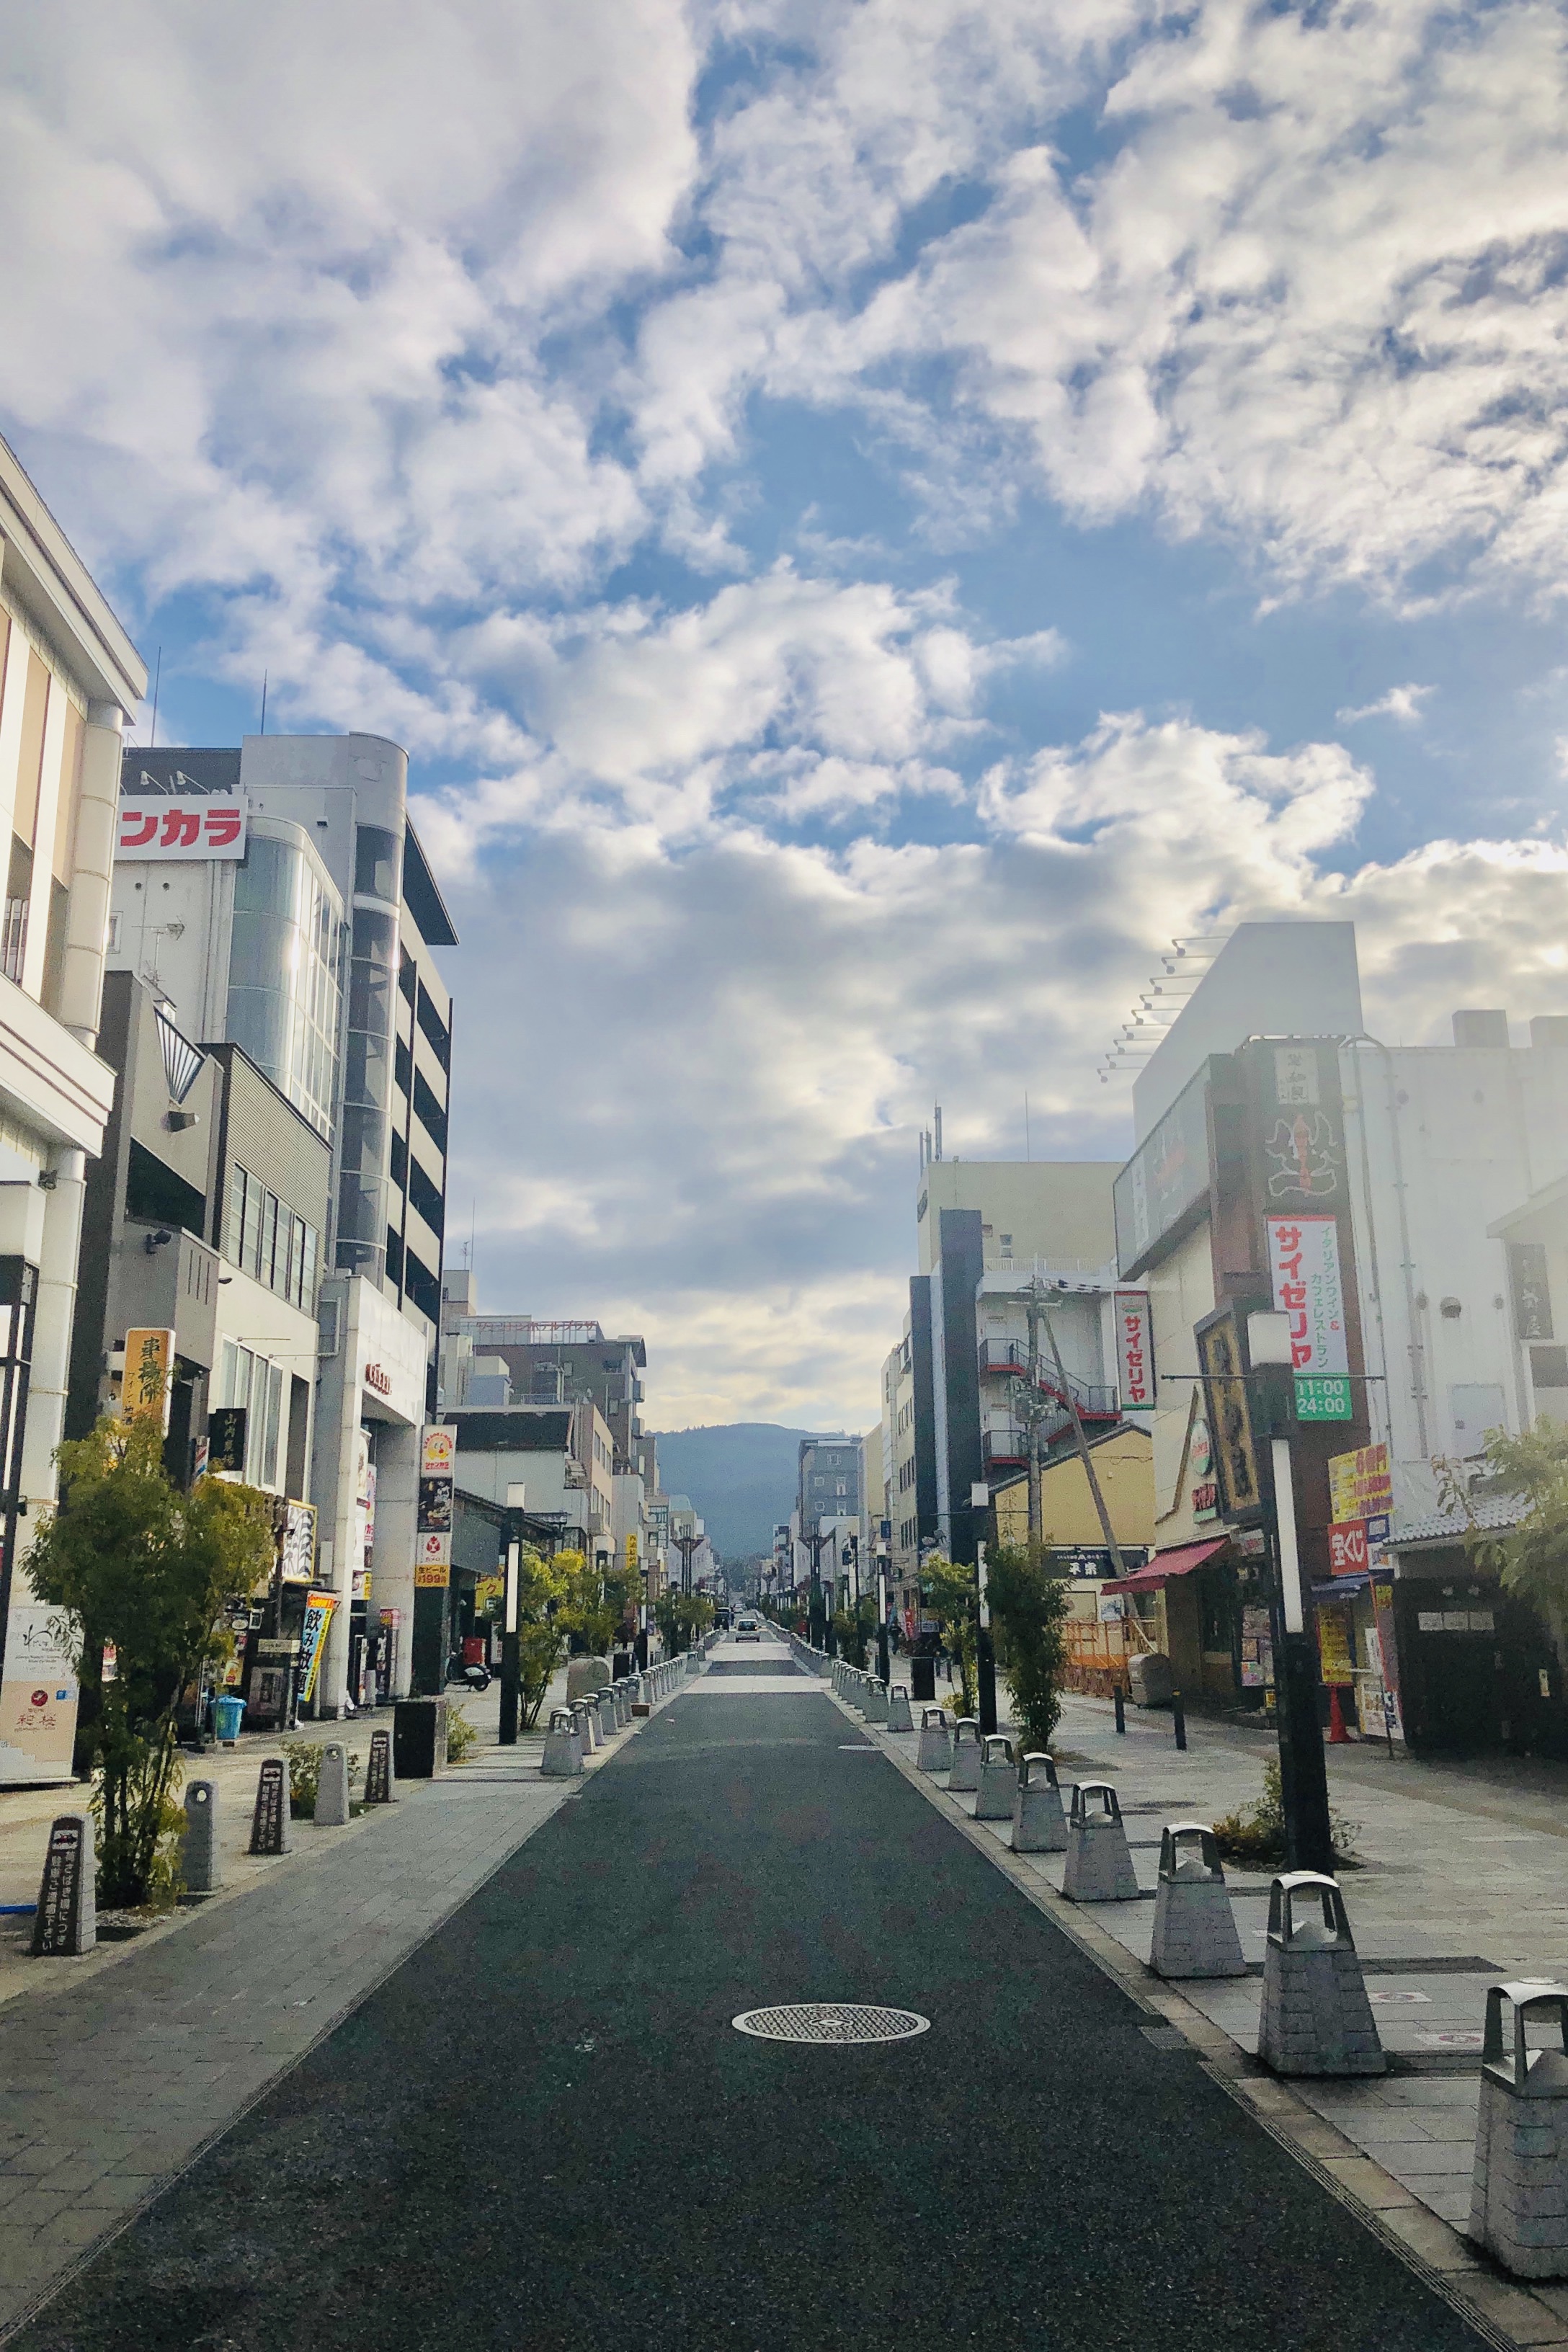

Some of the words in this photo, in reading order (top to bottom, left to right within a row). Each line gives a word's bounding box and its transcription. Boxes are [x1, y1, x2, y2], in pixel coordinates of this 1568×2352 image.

[120, 808, 241, 847] ンカラ
[1123, 1315, 1146, 1403] サイゼリヤ
[1296, 1380, 1344, 1396] 11:00
[1297, 1397, 1345, 1414] 24:00
[1332, 1529, 1364, 1566] 宝くじ
[1068, 1562, 1097, 1575] 平宗
